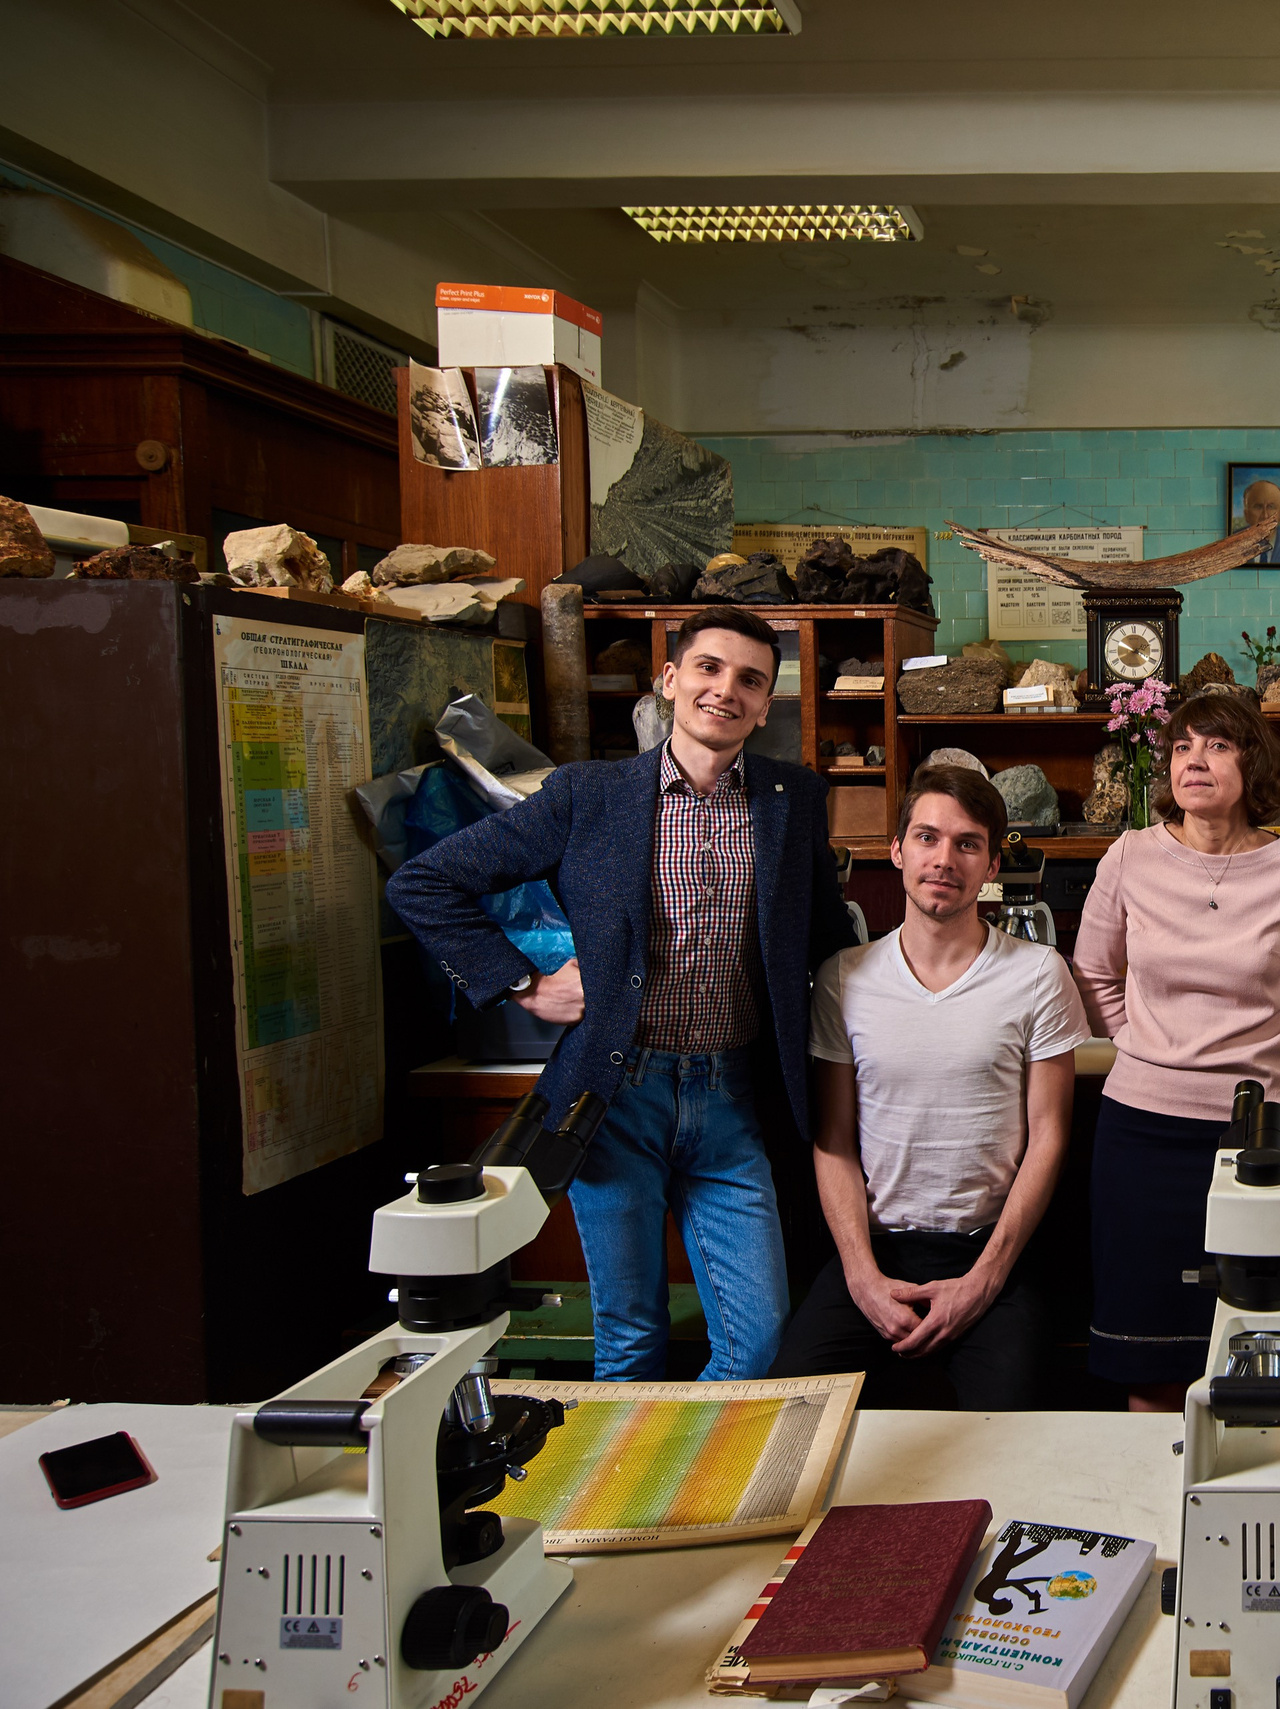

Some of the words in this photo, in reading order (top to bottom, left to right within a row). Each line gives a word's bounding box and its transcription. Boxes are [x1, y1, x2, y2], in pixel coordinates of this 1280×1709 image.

[439, 288, 459, 297] Perfect
[460, 289, 473, 297] Print
[473, 290, 485, 298] Plus
[1059, 533, 1100, 541] КАРБОНАТНЫХ
[1102, 532, 1122, 540] ПОРОД
[241, 632, 267, 643] ОБЩАЯ
[270, 635, 343, 651] СТРАТИГРАФИЧЕСКАЯ
[254, 646, 332, 661] (ГЕОХРОНОЛОГИЧЕСКАЯ)
[280, 660, 308, 670] ШКАЛА
[574, 1534, 660, 1545] НОМОГРАММА
[952, 1613, 1061, 1639] ГЕОЭКОЛОГИИ
[965, 1628, 1030, 1647] ОСНОВЫ
[940, 1637, 1063, 1667] КОНЦЕПТУАЛЬН
[940, 1650, 1024, 1672] С.П.ГОРШКОВ
[347, 1672, 361, 1693] 6
